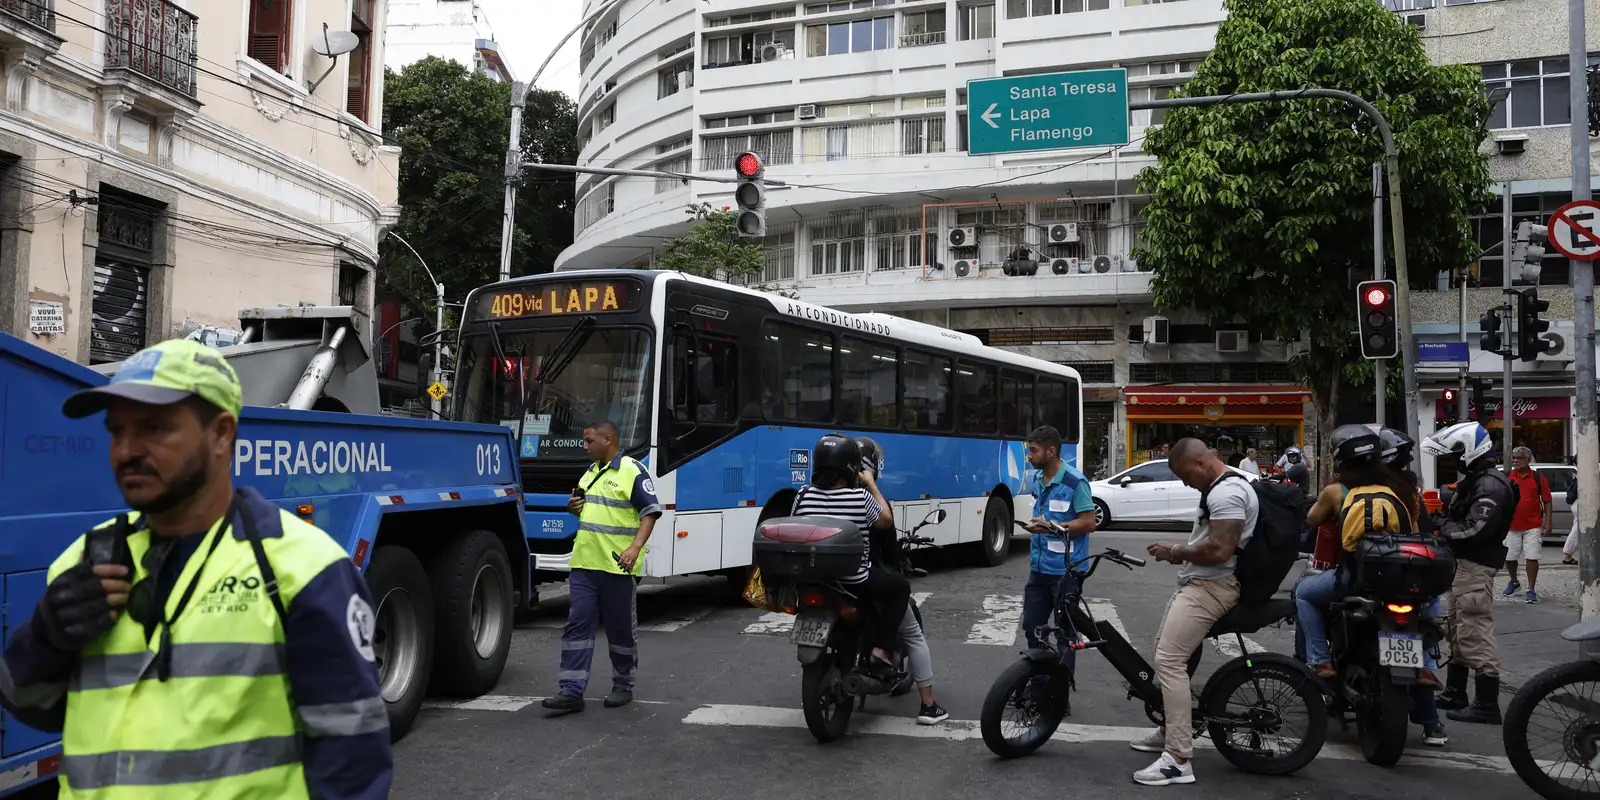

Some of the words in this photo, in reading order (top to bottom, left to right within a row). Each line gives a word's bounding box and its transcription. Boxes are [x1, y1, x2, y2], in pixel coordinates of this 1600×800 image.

[1010, 84, 1057, 100] Santa
[1060, 82, 1117, 96] Teresa
[1010, 107, 1051, 122] Lapa
[1010, 126, 1093, 142] Flamengo
[1569, 212, 1597, 249] E
[491, 293, 523, 317] 409
[525, 295, 543, 311] via
[550, 284, 619, 314] LAPA
[787, 302, 802, 317] AR
[806, 307, 891, 336] CONDICIONADO
[23, 434, 95, 454] CET-RIO
[540, 439, 551, 448] AR
[553, 439, 584, 448] CONDIC
[230, 438, 392, 477] PERACIONAL
[476, 443, 500, 476] 013
[797, 453, 808, 463] Rio
[791, 470, 806, 482] 1746
[608, 480, 619, 488] Rio
[541, 519, 564, 528] A71518
[1388, 638, 1414, 652] LSQ
[1385, 650, 1419, 665] 9C56
